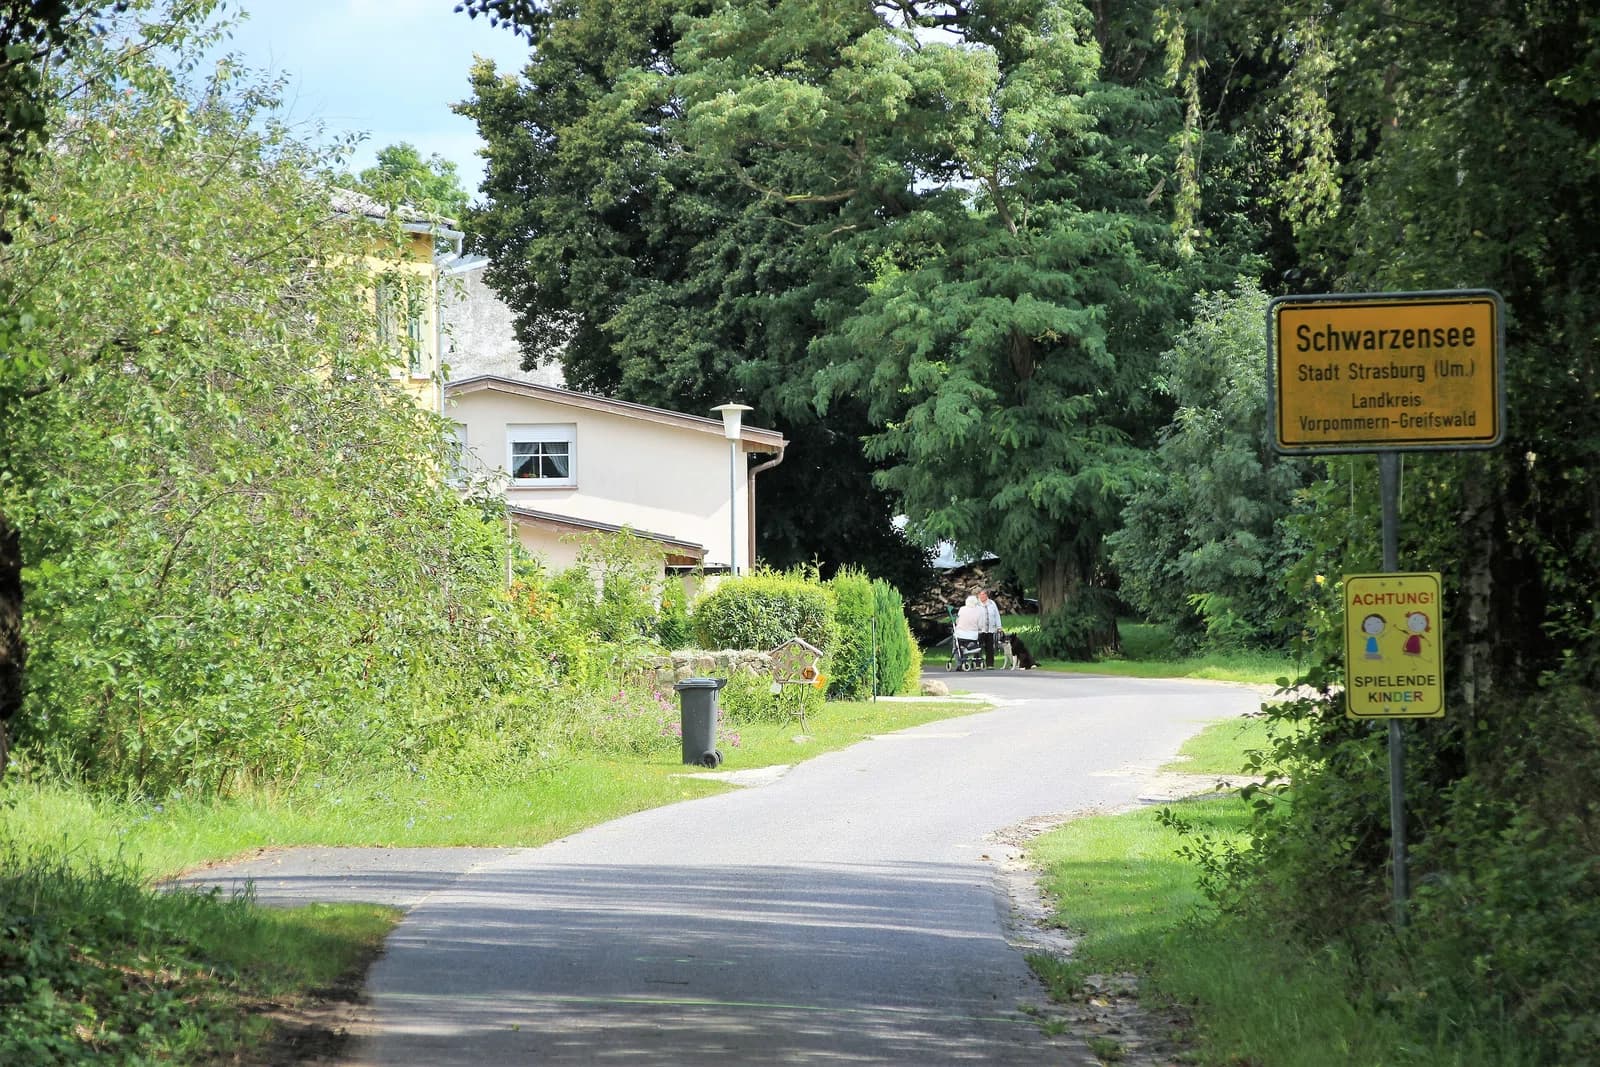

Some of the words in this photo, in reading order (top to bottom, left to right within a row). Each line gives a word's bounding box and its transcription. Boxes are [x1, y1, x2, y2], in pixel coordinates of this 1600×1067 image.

[1296, 324, 1476, 352] Schwarzensee
[1298, 363, 1340, 382] Stadt
[1348, 361, 1426, 383] Strasburg
[1434, 358, 1475, 378] (Um.)
[1352, 392, 1422, 409] Landkreis
[1299, 411, 1477, 434] Vorpommern-Greifswald
[1352, 592, 1434, 606] ACHTUNG!
[1354, 675, 1436, 687] SPIELENDE
[1368, 691, 1424, 703] KINDER
